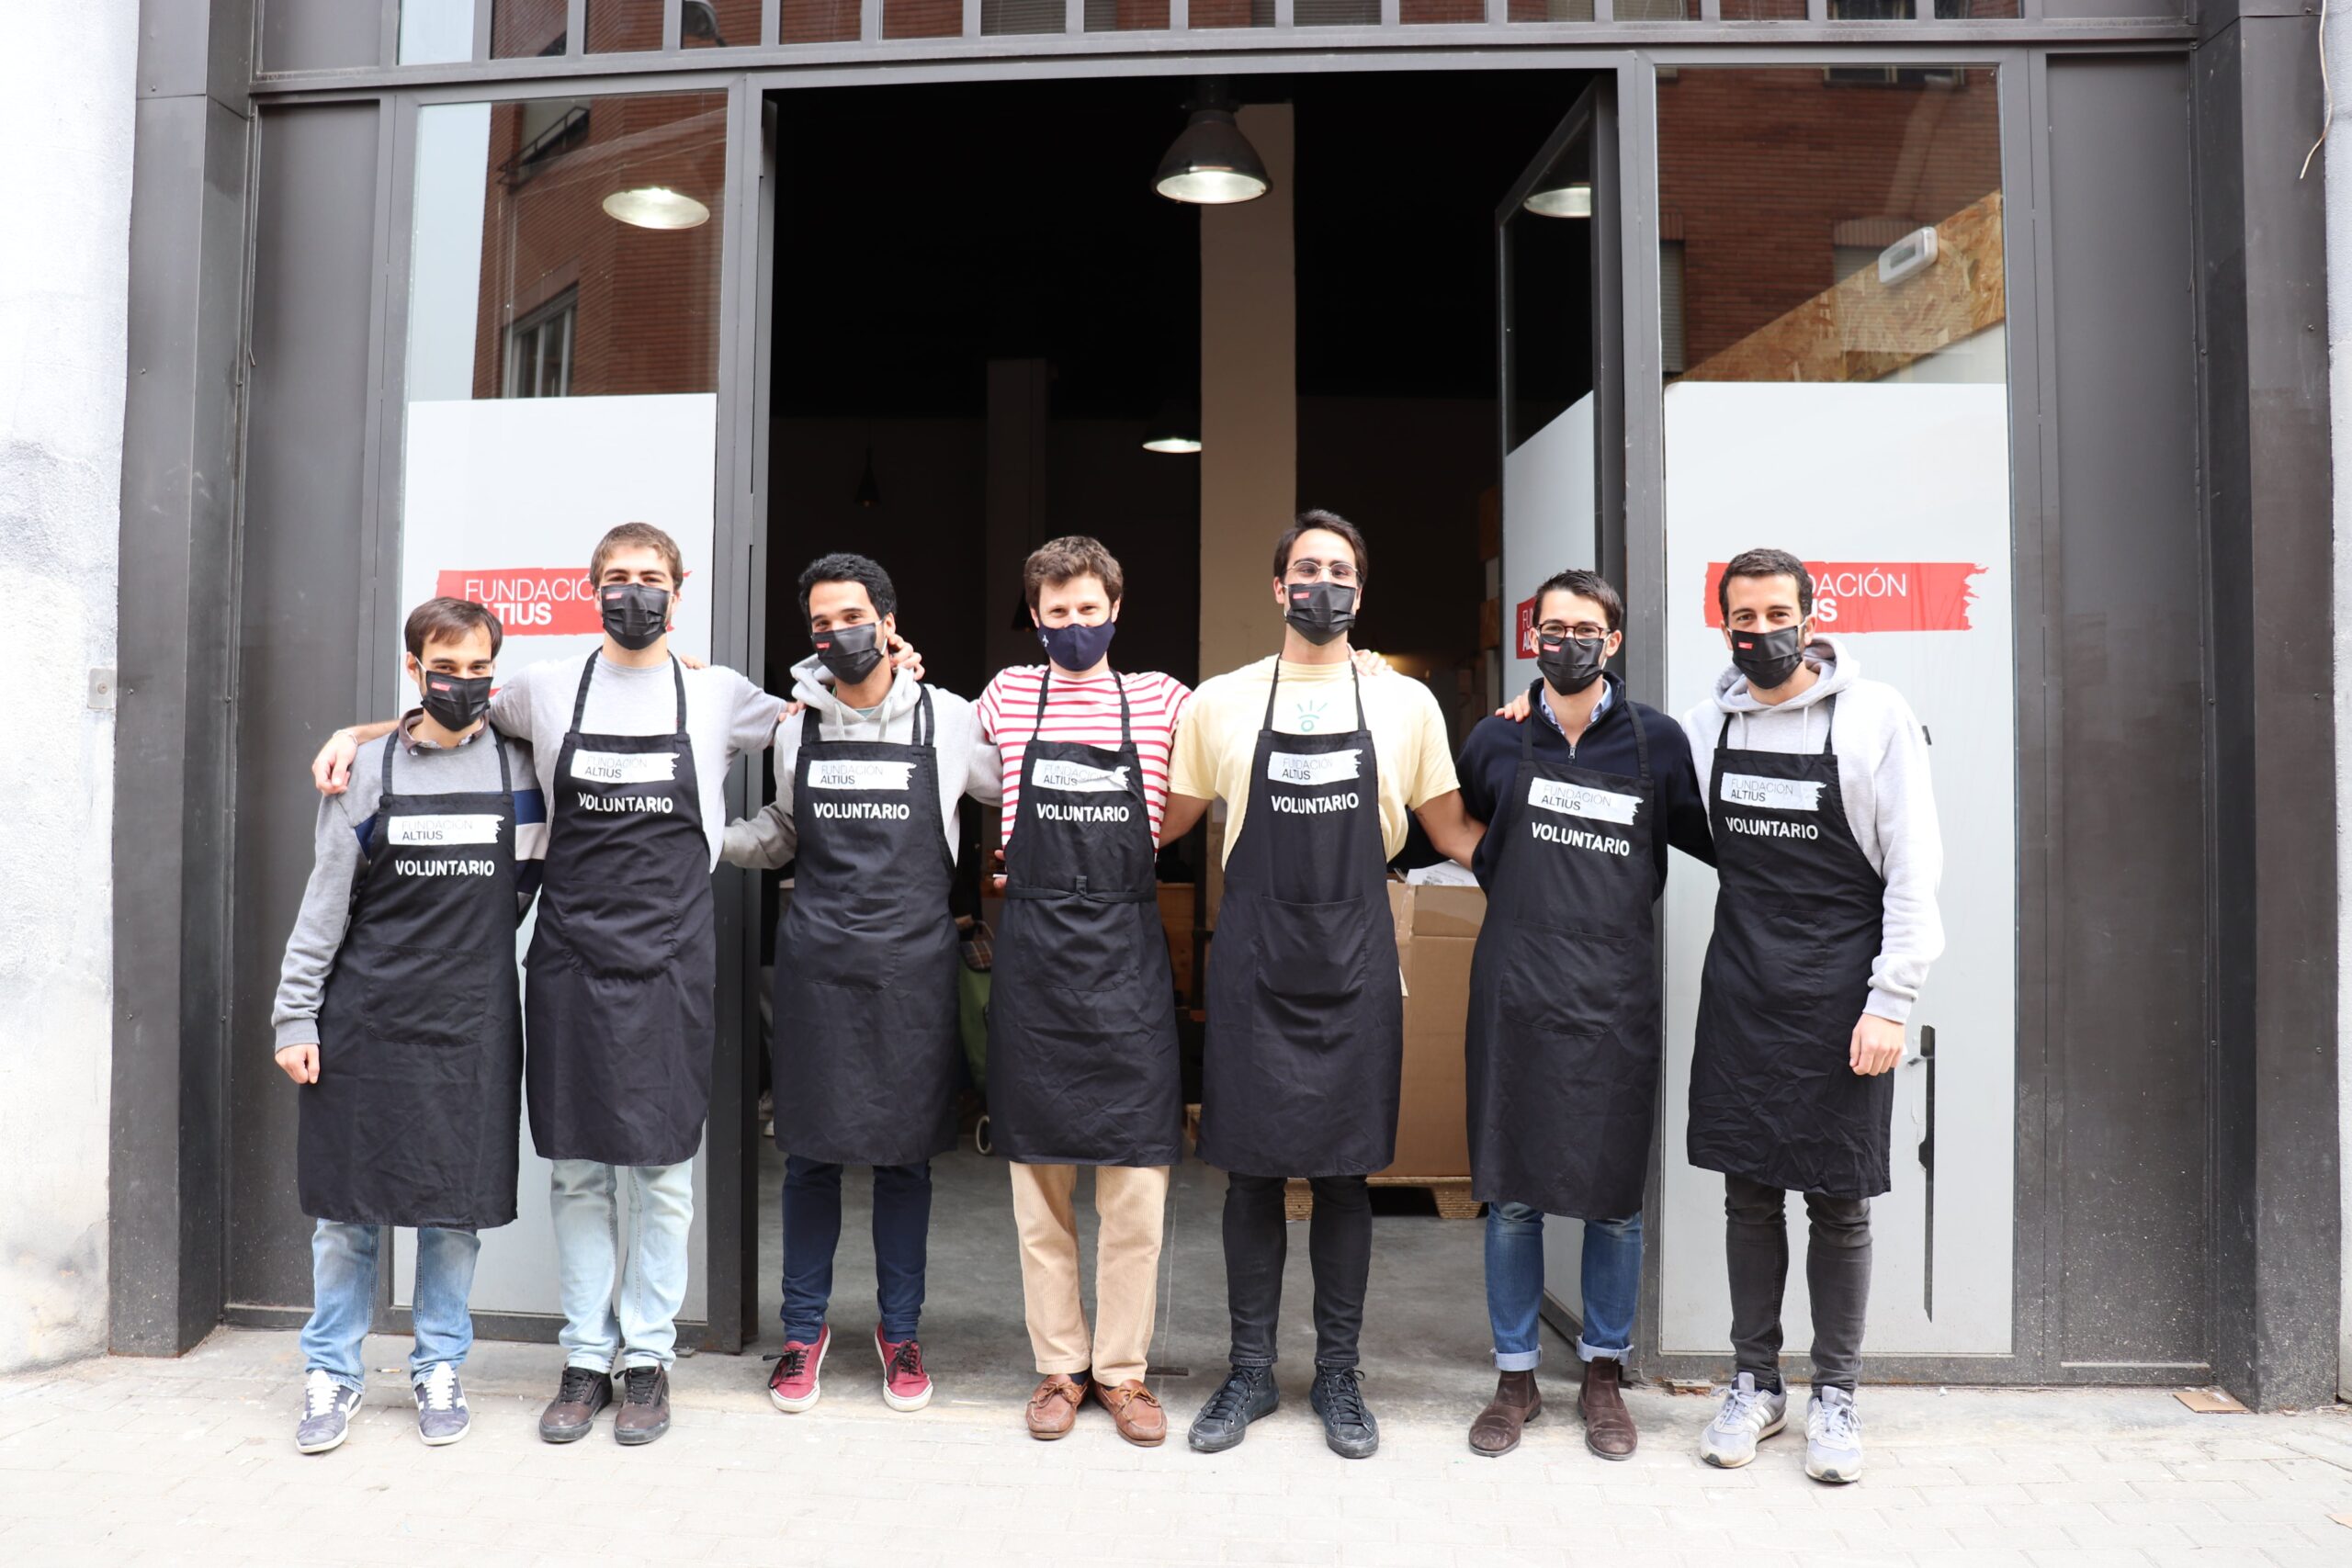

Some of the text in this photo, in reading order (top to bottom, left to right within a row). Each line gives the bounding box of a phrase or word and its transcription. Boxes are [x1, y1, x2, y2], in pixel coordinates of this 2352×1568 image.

[465, 573, 594, 602] FUNDACIÓ
[484, 603, 552, 626] TIUS
[584, 766, 623, 779] ALTIUS
[820, 774, 856, 784] ALTIUS
[1043, 774, 1079, 786] ALTIUS
[1282, 768, 1311, 780] ALTIUS
[577, 792, 673, 814] VOLUNTARIO
[1271, 792, 1360, 814] VOLUNTARIO
[1541, 795, 1581, 811] ALTIUS
[1731, 789, 1766, 802] ALTIUS
[813, 802, 910, 820] VOLUNTARIO
[1036, 803, 1129, 822] VOLUNTARIO
[402, 830, 444, 840] ALTIUS
[1724, 816, 1819, 840] VOLUNTARIO
[1532, 821, 1631, 856] VOLUNTARIO
[395, 859, 495, 876] VOLUNTARIO
